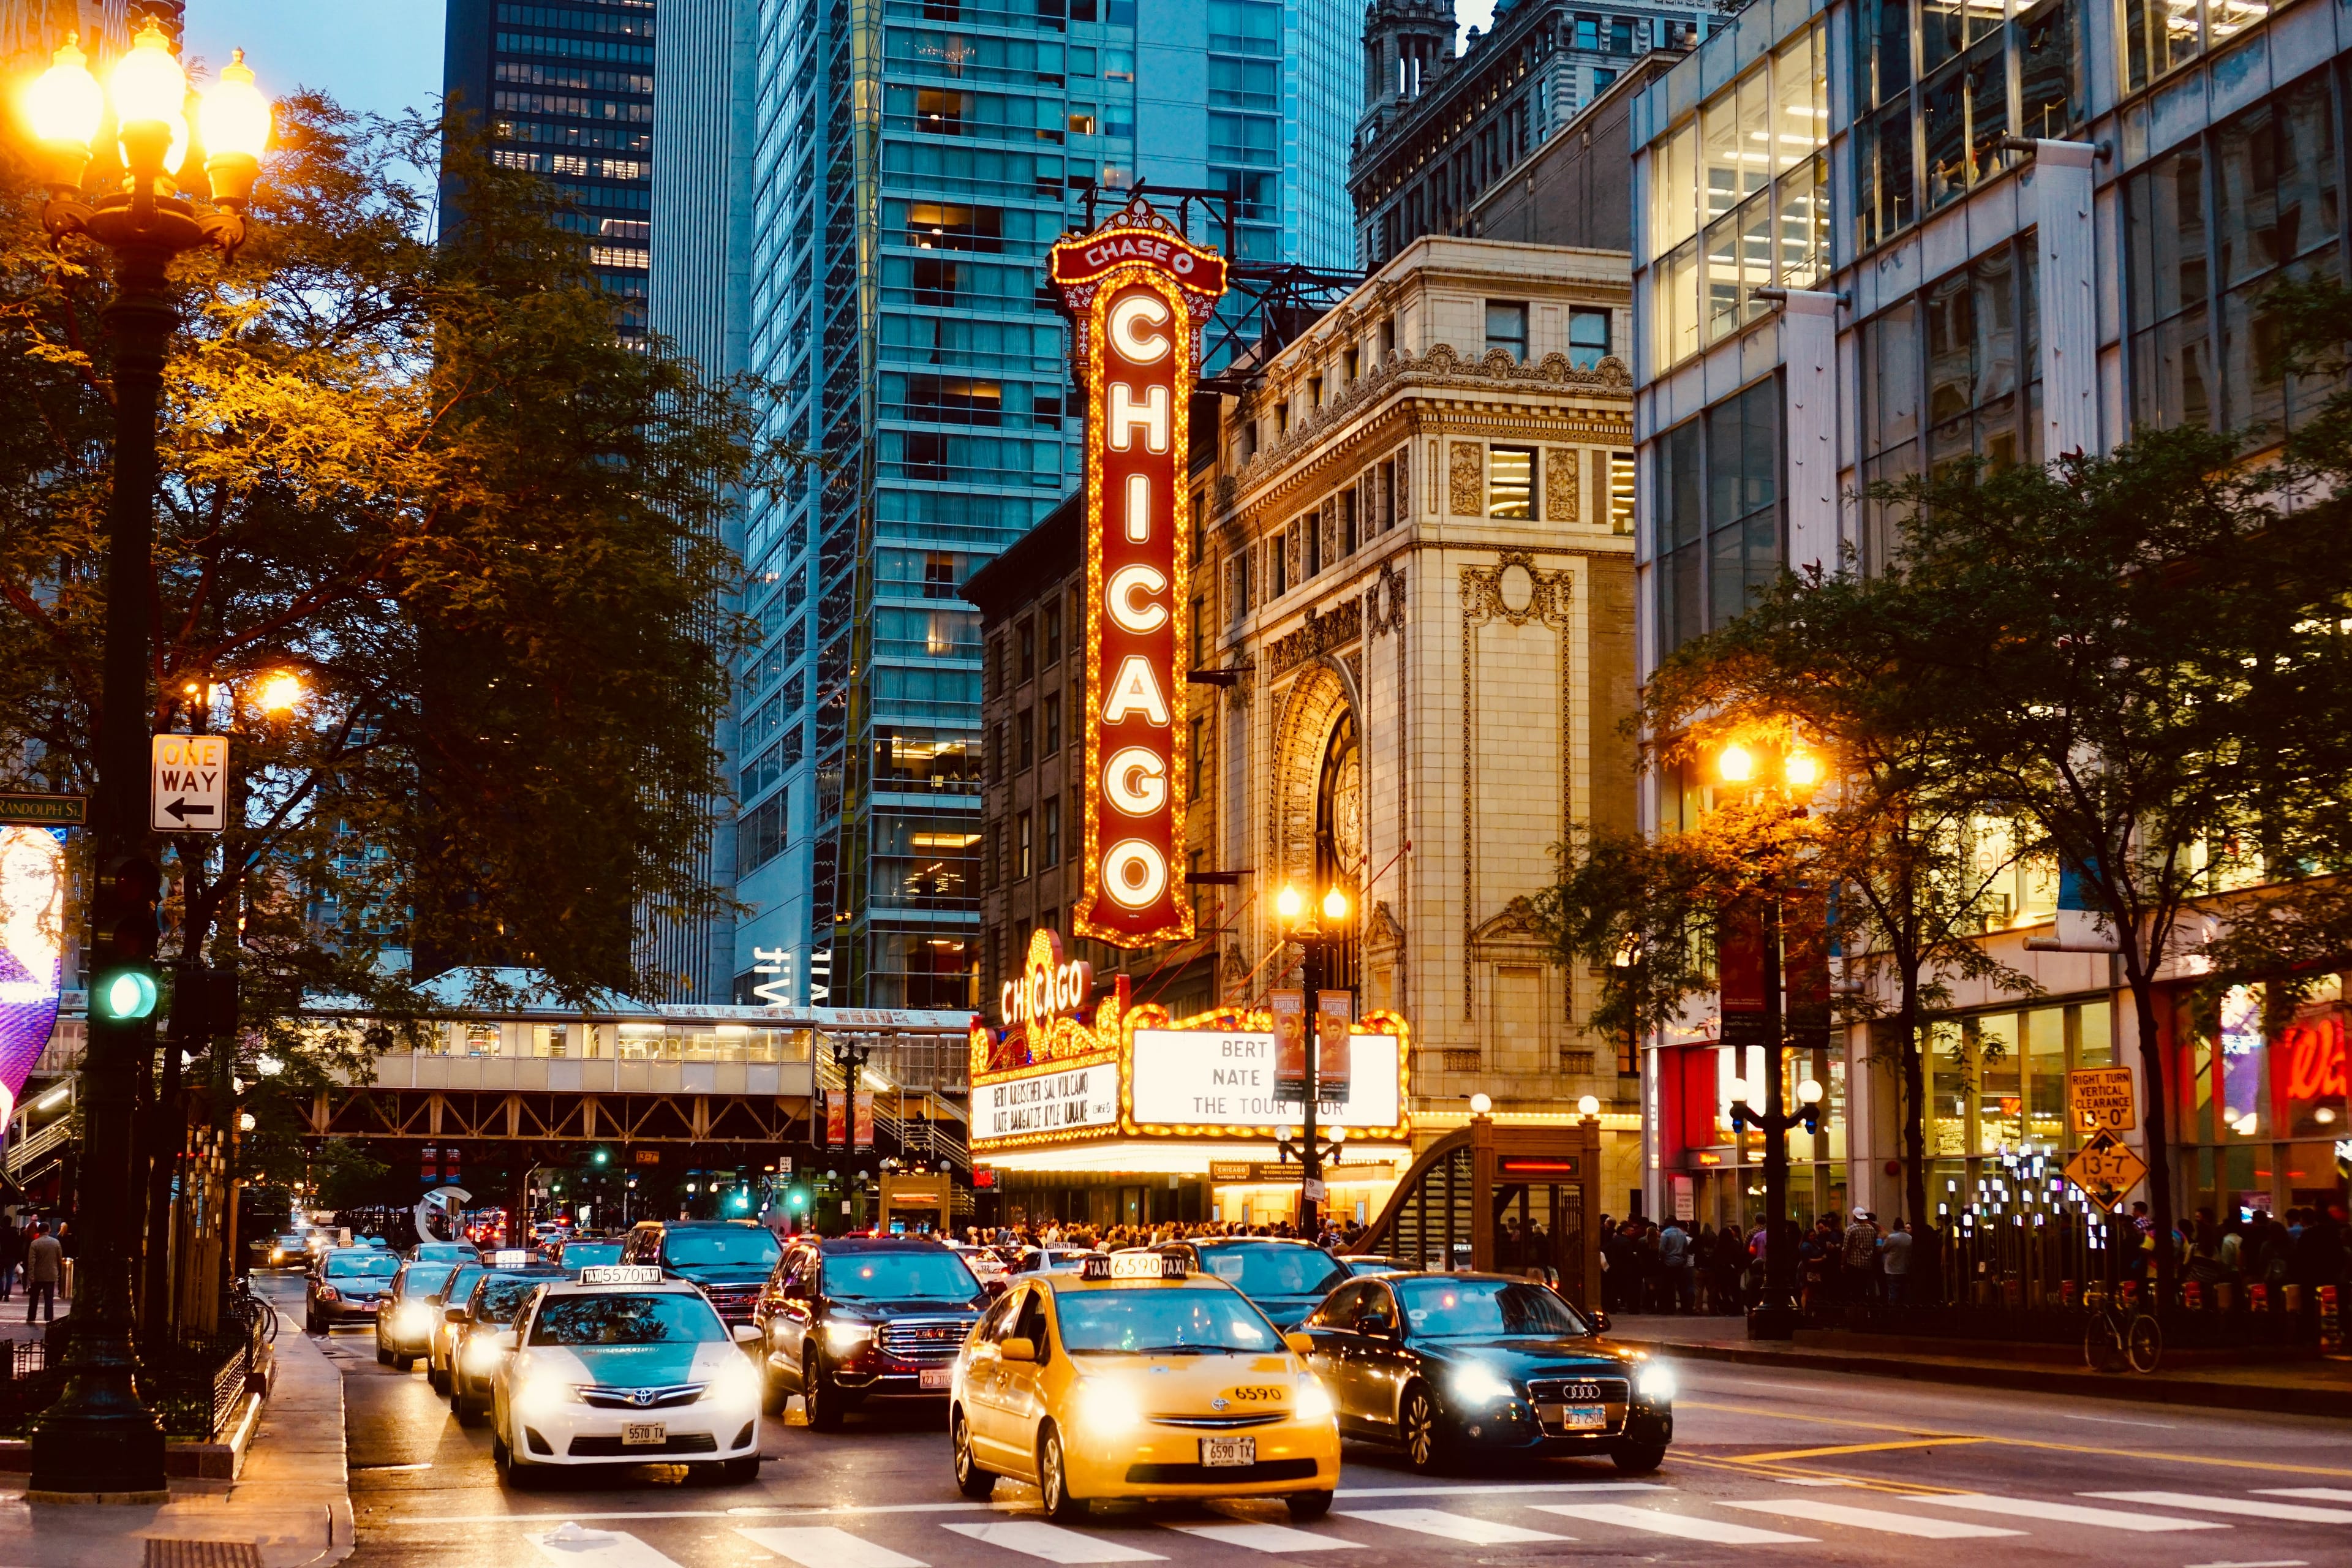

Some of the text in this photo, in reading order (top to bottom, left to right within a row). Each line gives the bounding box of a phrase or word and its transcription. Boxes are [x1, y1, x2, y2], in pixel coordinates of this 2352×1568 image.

[1085, 239, 1170, 267] CHASE
[1101, 295, 1170, 910] CHICAGO
[164, 744, 216, 766] ONE
[162, 771, 217, 792] WAY
[1001, 959, 1082, 1025] CHICAGO
[1273, 1000, 1300, 1009] HEARTBREAK
[1321, 1002, 1348, 1011] HEARTBREAK
[1222, 1041, 1267, 1058] BERT
[1213, 1069, 1260, 1086] NATE
[2073, 1073, 2130, 1085] RIGHT TURN
[994, 1086, 1006, 1108] BERT
[1044, 1079, 1055, 1099] SAL
[1058, 1072, 1088, 1098] VULCANO
[2079, 1085, 2124, 1096] VERTICAL
[1194, 1097, 1227, 1114] THE
[1239, 1098, 1287, 1115] TOUR
[2075, 1097, 2130, 1109] CLEARANCE
[993, 1112, 1007, 1133] NATE
[1011, 1106, 1041, 1131] BARGATZE
[1044, 1104, 1060, 1126] KYLE
[585, 1268, 658, 1283] TAXI 5570 TAXI
[1088, 1258, 1185, 1276] TAXI 6590 TAXI
[1235, 1388, 1281, 1400] 6590
[1585, 1412, 1604, 1423] 2506
[630, 1428, 664, 1439] 5570 TX
[1210, 1446, 1250, 1458] 6590 TX
